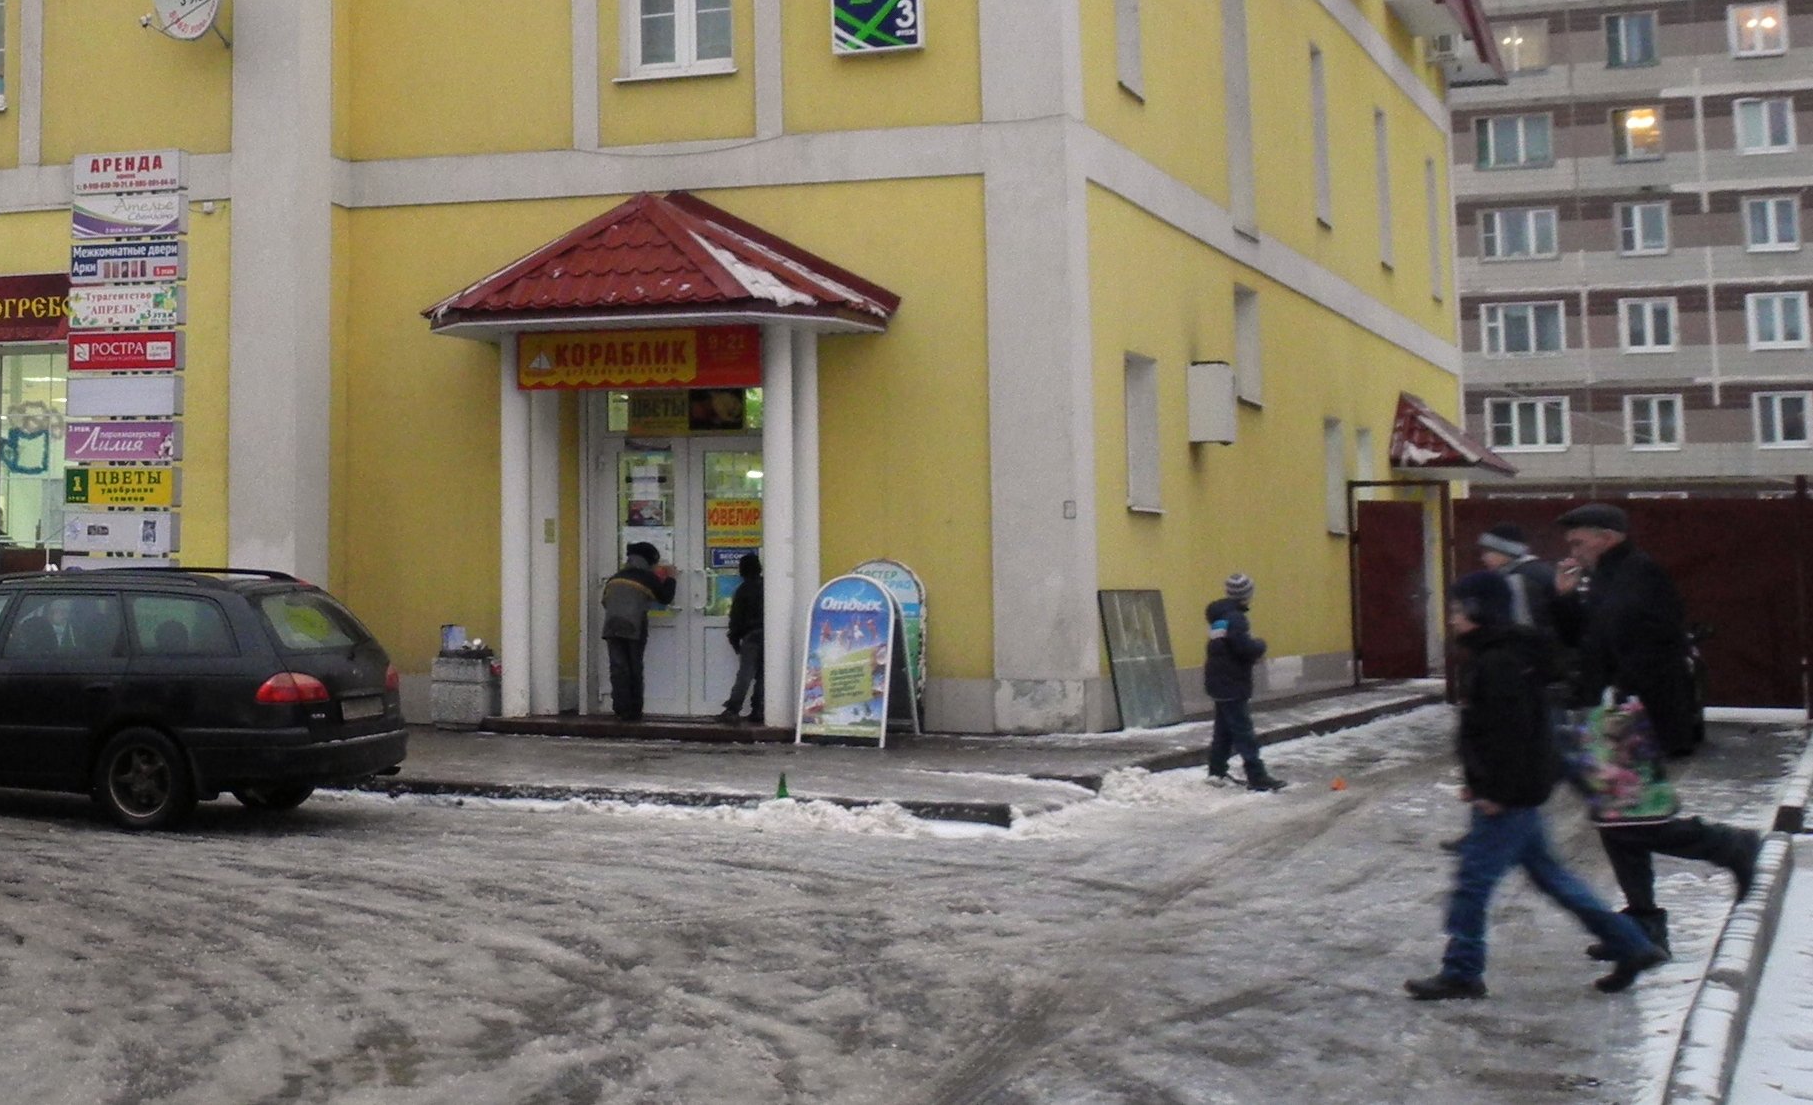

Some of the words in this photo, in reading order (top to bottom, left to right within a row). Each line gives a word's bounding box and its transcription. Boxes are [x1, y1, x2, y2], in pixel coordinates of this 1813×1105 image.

[90, 154, 163, 173] АРЕНДА
[112, 198, 174, 215] Ателье
[73, 245, 147, 258] Межкомнатные
[148, 243, 177, 257] двери
[72, 261, 97, 275] Арки
[86, 292, 152, 302] Турагентство
[91, 341, 145, 355] РОСТРА
[555, 340, 687, 369] КОРАБЛИК
[75, 426, 143, 454] Лилия
[94, 471, 162, 486] ЦВЕТЫ
[708, 507, 761, 526] ЮВЕЛИР
